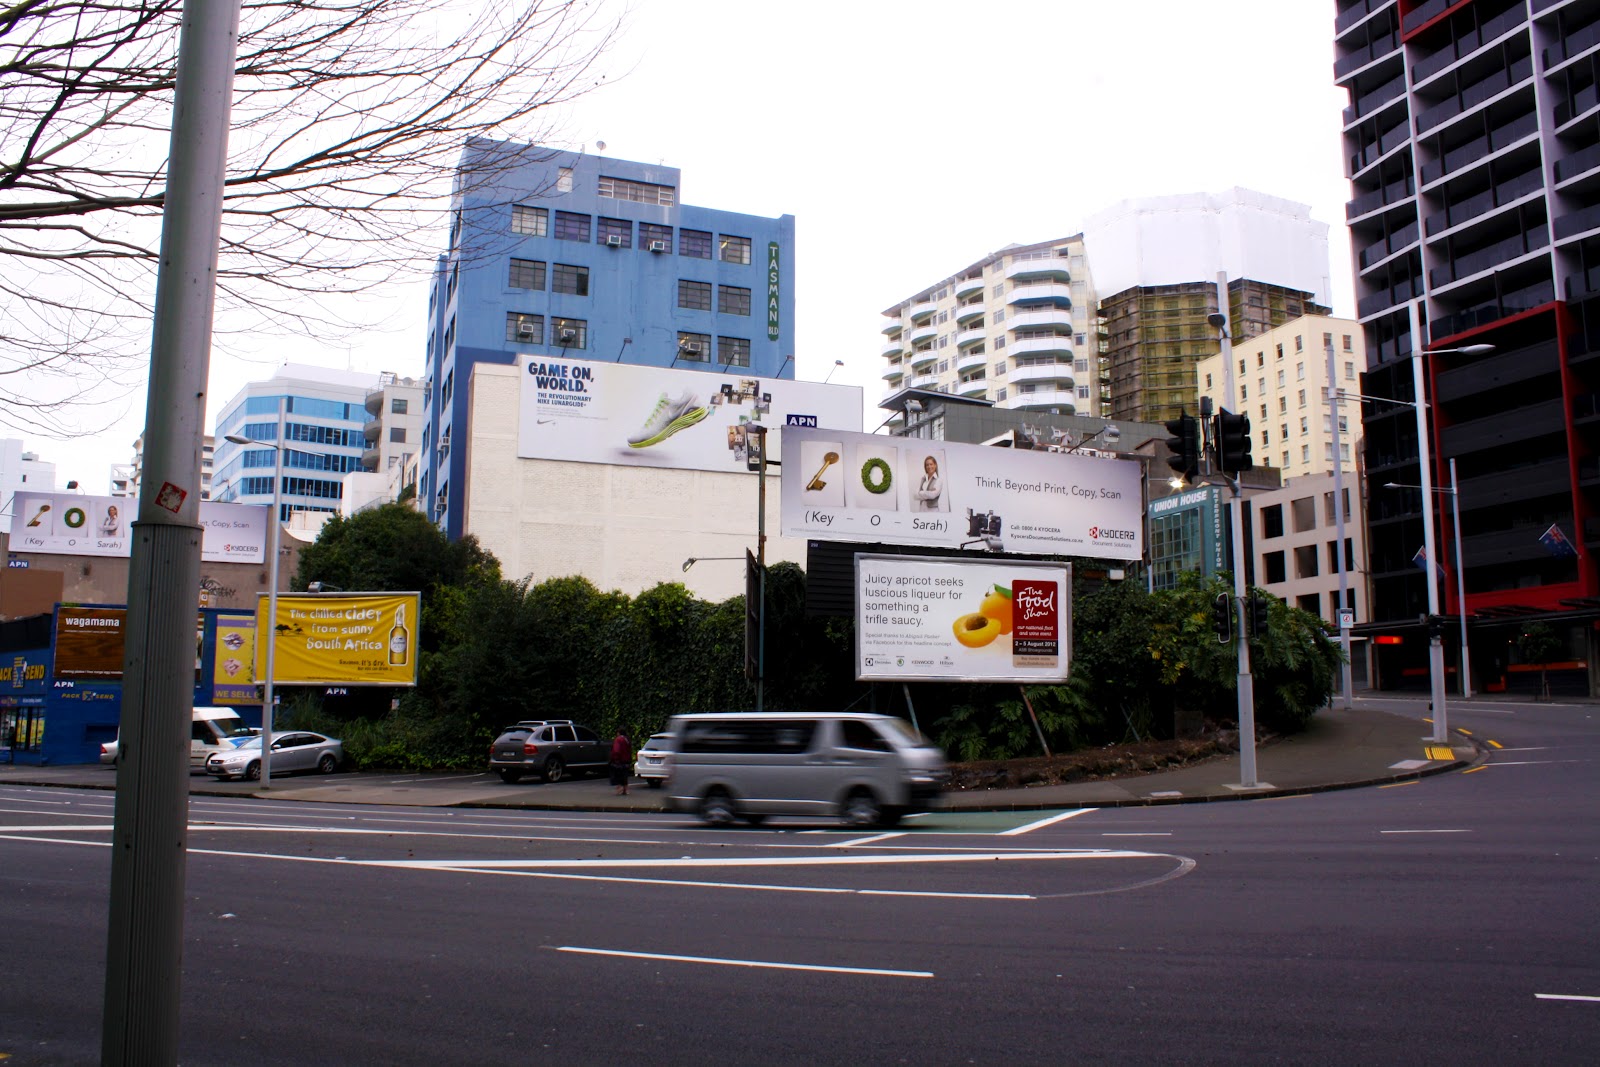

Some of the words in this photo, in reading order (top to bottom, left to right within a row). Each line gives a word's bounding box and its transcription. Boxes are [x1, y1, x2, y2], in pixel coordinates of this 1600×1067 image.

[769, 246, 778, 322] TASMAN
[768, 326, 779, 335] BLD
[528, 362, 568, 378] GAME
[571, 366, 595, 382] ON,
[536, 376, 588, 393] WORLD.
[549, 393, 592, 402] REVOLUTIONARY
[789, 416, 816, 427] APN
[975, 476, 1002, 489] Think
[1004, 479, 1042, 494] Beyond
[1044, 482, 1069, 496] Print,
[1071, 485, 1098, 500] Copy,
[1100, 488, 1121, 500] Scan
[1154, 497, 1178, 513] UNION
[1180, 490, 1207, 506] HOUSE
[1212, 488, 1221, 539] WATERFRONT
[212, 520, 232, 528] Copy,
[233, 520, 250, 529] Scan
[805, 510, 835, 526] (Key
[870, 514, 881, 526] O
[913, 518, 948, 533] Sarah)
[24, 537, 45, 547] (Key
[68, 538, 76, 547] O
[97, 540, 122, 550] Sarah)
[865, 573, 893, 587] Juicy
[895, 575, 932, 588] apricot
[934, 577, 964, 587] seeks
[865, 587, 908, 598] luscious
[911, 588, 945, 601] liqueur
[948, 589, 963, 600] for
[1024, 586, 1043, 596] The
[865, 601, 919, 614] something
[922, 603, 929, 612] a
[1016, 591, 1054, 612] Food
[289, 609, 306, 619] The
[309, 608, 343, 619] chilled
[865, 613, 888, 625] trifle
[891, 616, 924, 628] saucy.
[1023, 607, 1049, 620] Show
[65, 617, 120, 627] wagamama
[312, 623, 338, 633] from
[341, 625, 374, 635] sunny
[306, 636, 341, 650] South
[343, 637, 383, 652] Africa
[25, 664, 45, 680] SEND
[215, 690, 229, 698] WE
[231, 690, 251, 698] SELL
